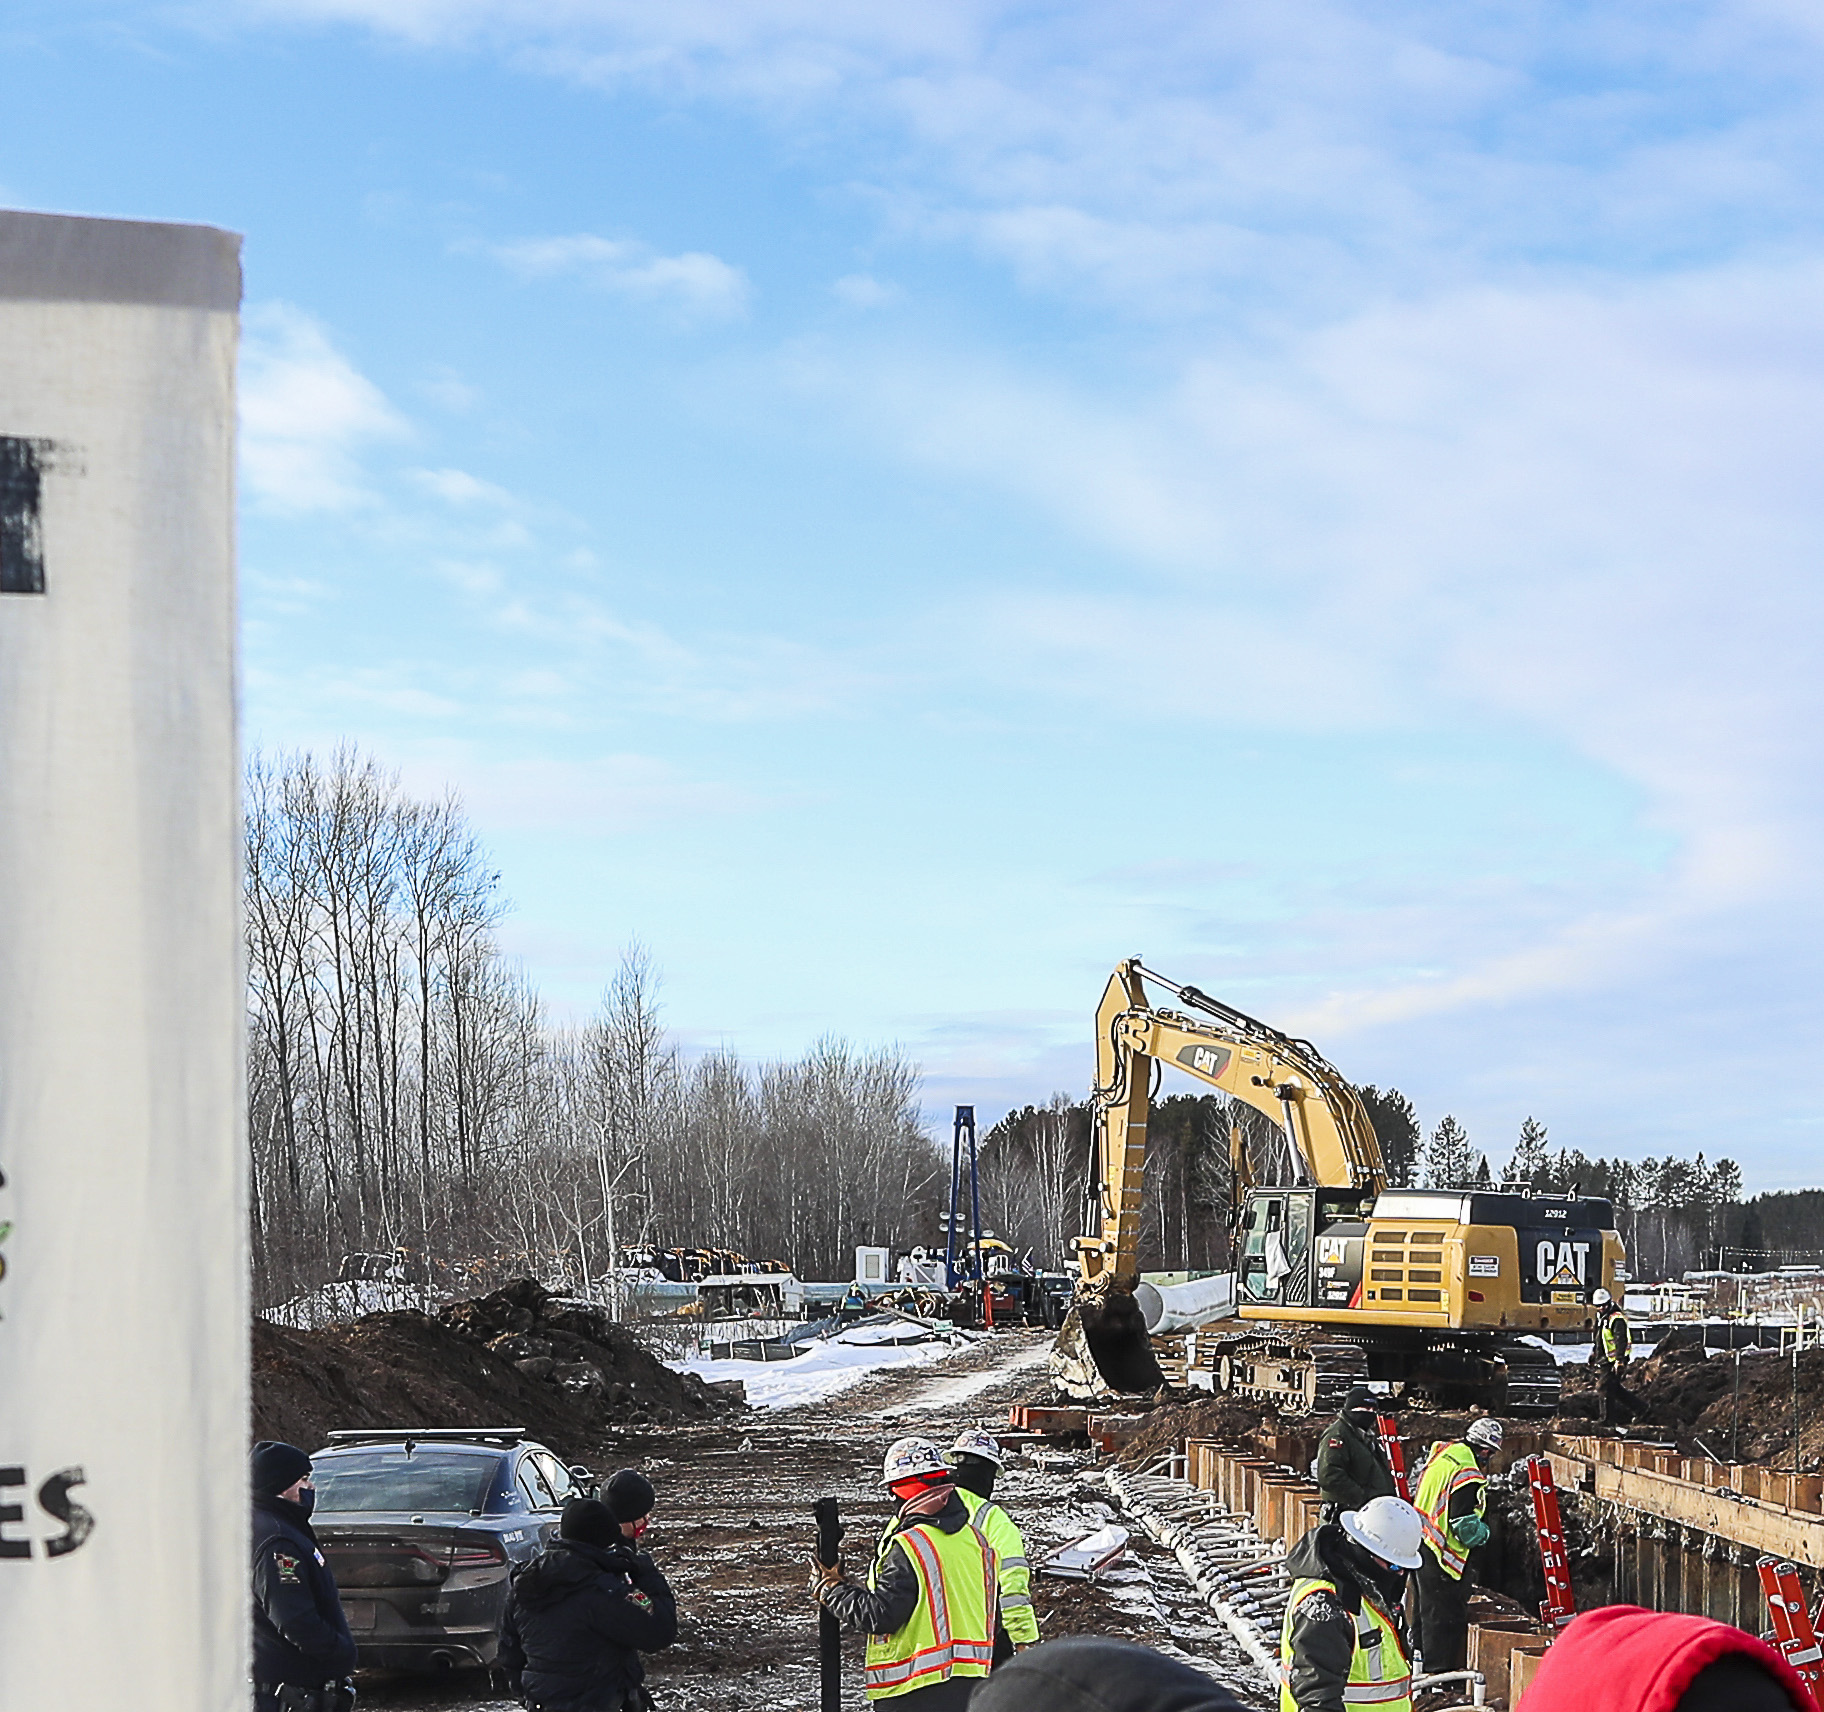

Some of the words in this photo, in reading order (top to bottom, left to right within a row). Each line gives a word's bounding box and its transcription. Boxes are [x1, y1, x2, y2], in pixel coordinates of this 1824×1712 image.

[1194, 1046, 1218, 1075] CAT
[1319, 1237, 1348, 1264] CAT
[1536, 1240, 1590, 1286] CAT
